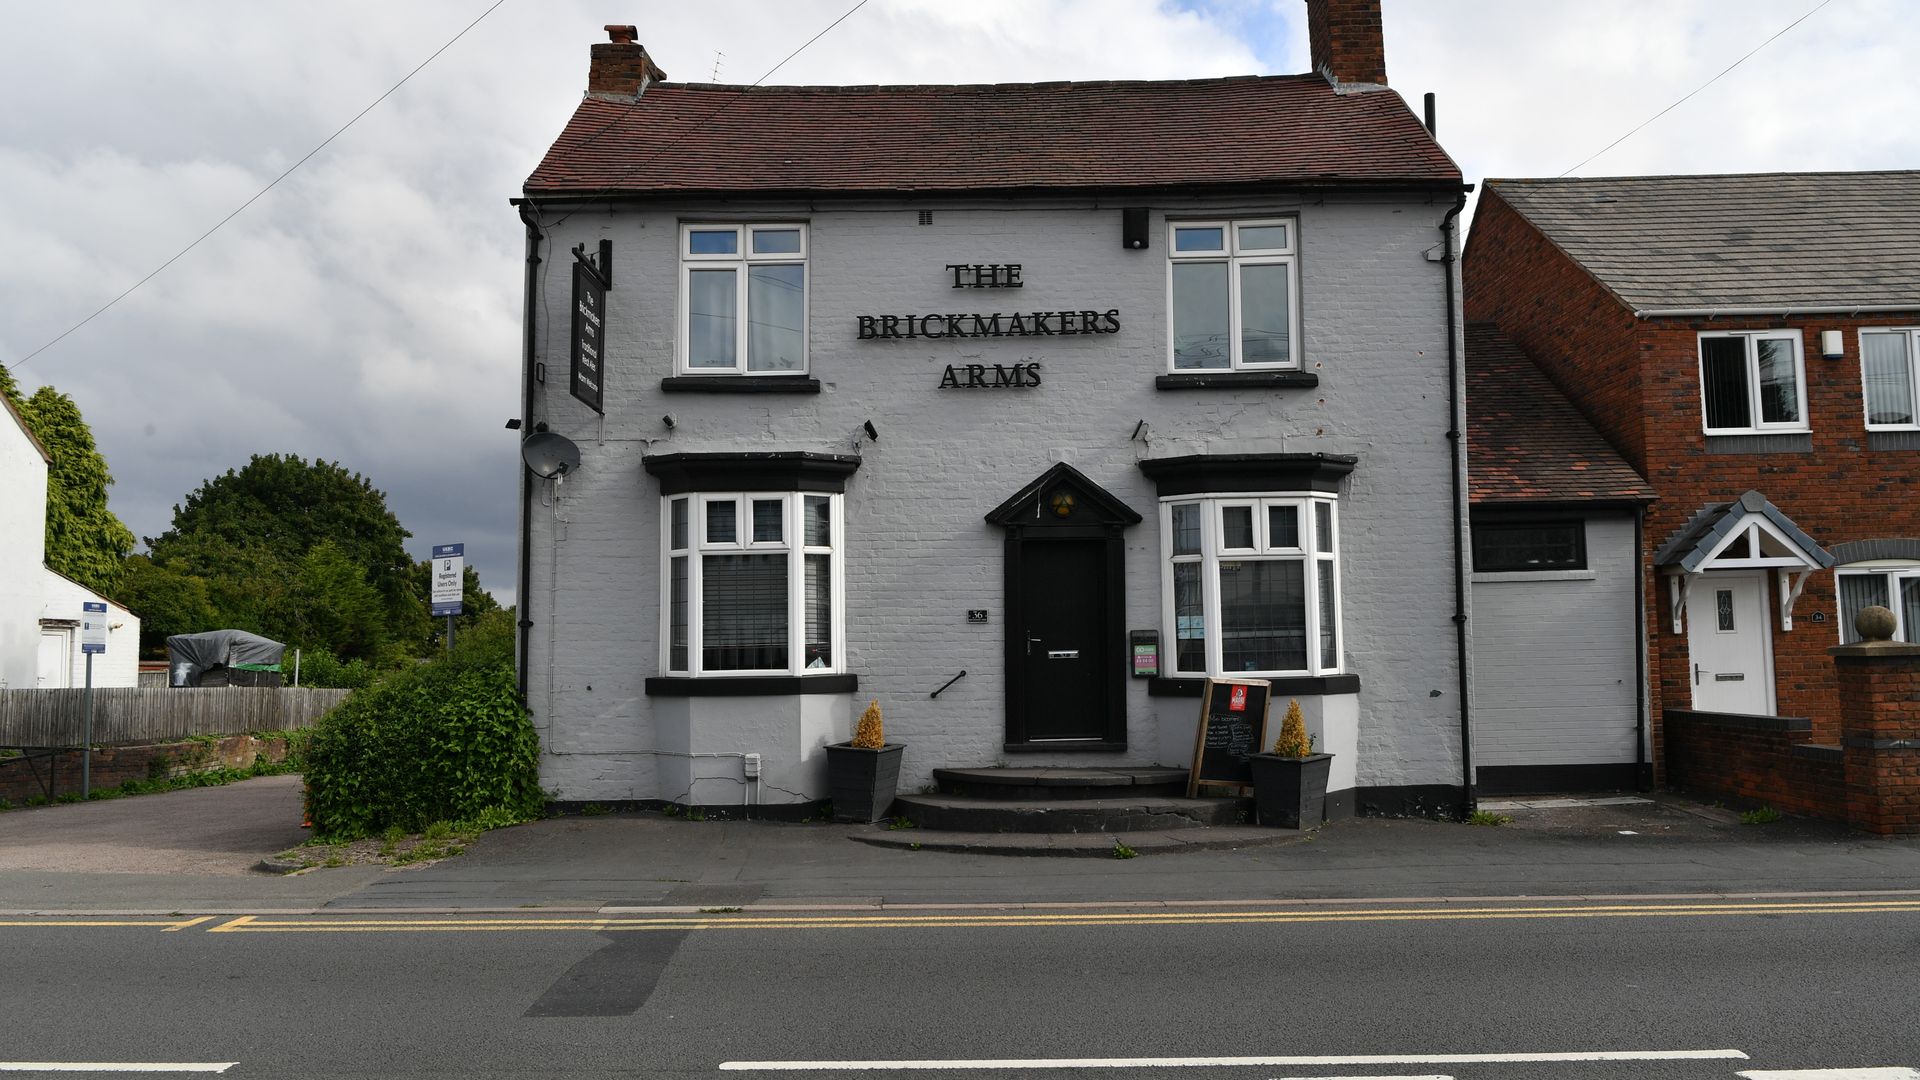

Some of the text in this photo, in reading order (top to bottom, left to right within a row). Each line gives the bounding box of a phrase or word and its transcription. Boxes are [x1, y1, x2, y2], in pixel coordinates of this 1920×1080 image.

[946, 264, 1023, 288] THE
[586, 291, 594, 307] The
[579, 299, 600, 327] Brickmakers
[857, 309, 1121, 339] BRICKMAKERS
[585, 322, 595, 338] Arms
[938, 363, 1042, 389] ARMS
[448, 580, 457, 588] Only
